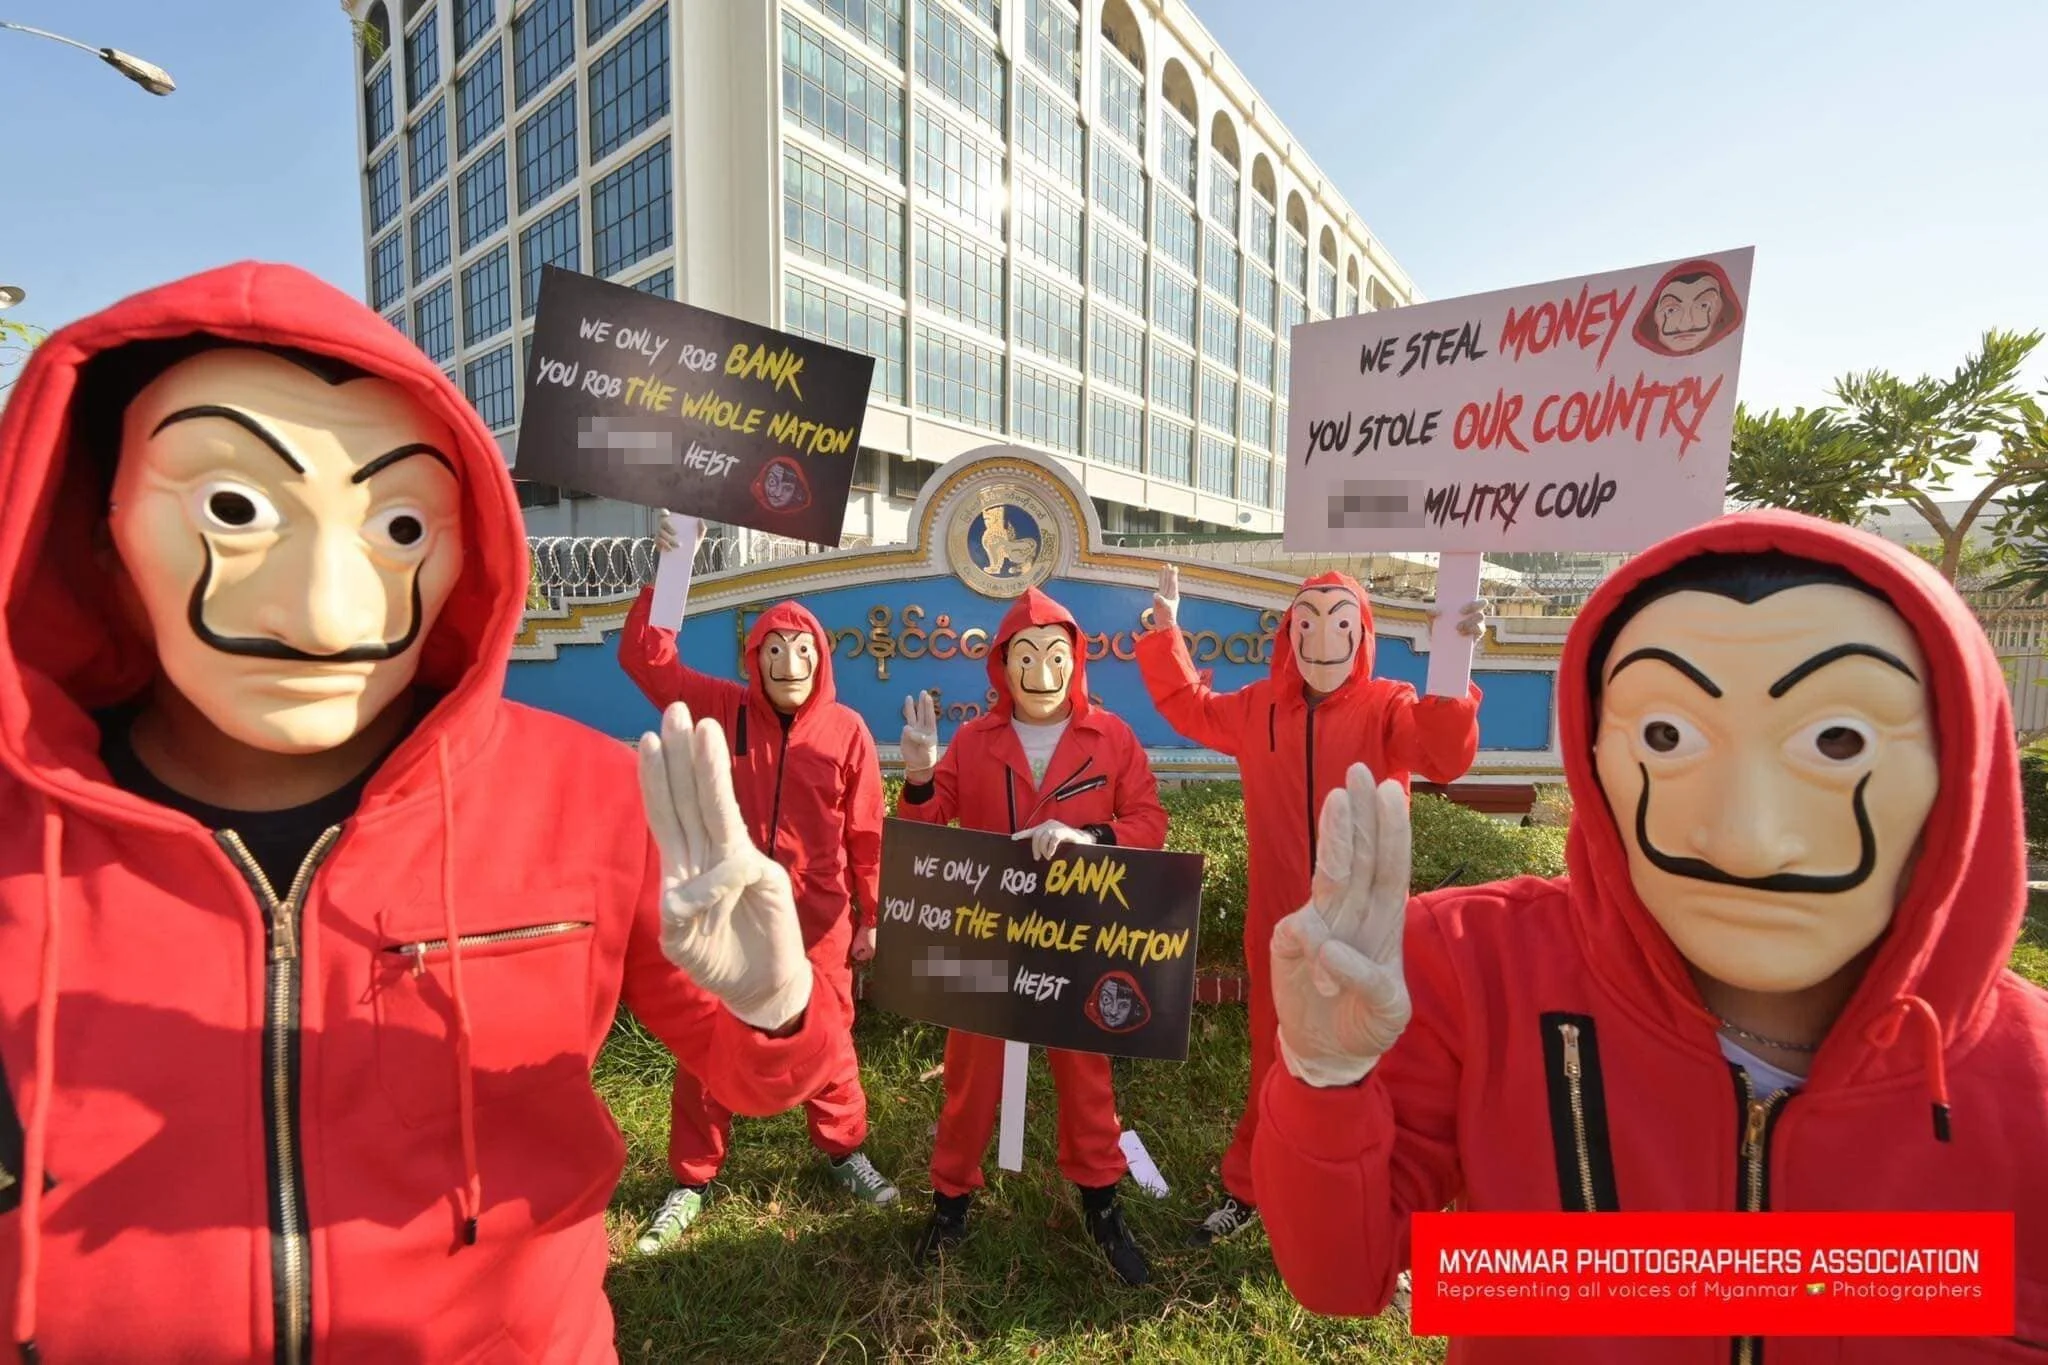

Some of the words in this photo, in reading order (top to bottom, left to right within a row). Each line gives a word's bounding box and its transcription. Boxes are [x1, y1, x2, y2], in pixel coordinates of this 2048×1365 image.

[579, 316, 613, 343] WE
[615, 327, 669, 366] ONLY
[678, 344, 717, 373] ROB
[724, 343, 804, 402] BANK
[1360, 336, 1397, 375] WE
[1397, 319, 1488, 377] STEAL
[1499, 282, 1637, 372] MONEY
[536, 356, 578, 387] YOU
[581, 370, 621, 399] ROB
[623, 373, 677, 412] THE
[681, 389, 765, 434] WHOLE
[767, 411, 853, 456] NATION
[1304, 411, 1352, 467] YOU
[1352, 408, 1442, 458] STOLE
[1452, 387, 1529, 453] OUR
[1532, 370, 1724, 462] COUNTRY
[683, 440, 740, 478] HEIST
[1424, 481, 1530, 533] MILITRY
[1535, 471, 1617, 518] COUP
[914, 855, 938, 878] WE
[943, 857, 990, 894] ONLY
[1000, 868, 1037, 895] ROB
[1045, 855, 1129, 910] BANK
[883, 895, 914, 922] YOU
[918, 903, 951, 931] ROB
[954, 901, 1001, 939] THE
[1007, 909, 1091, 952] WHOLE
[1095, 921, 1189, 967] NATION
[1013, 965, 1070, 1001] HEIST
